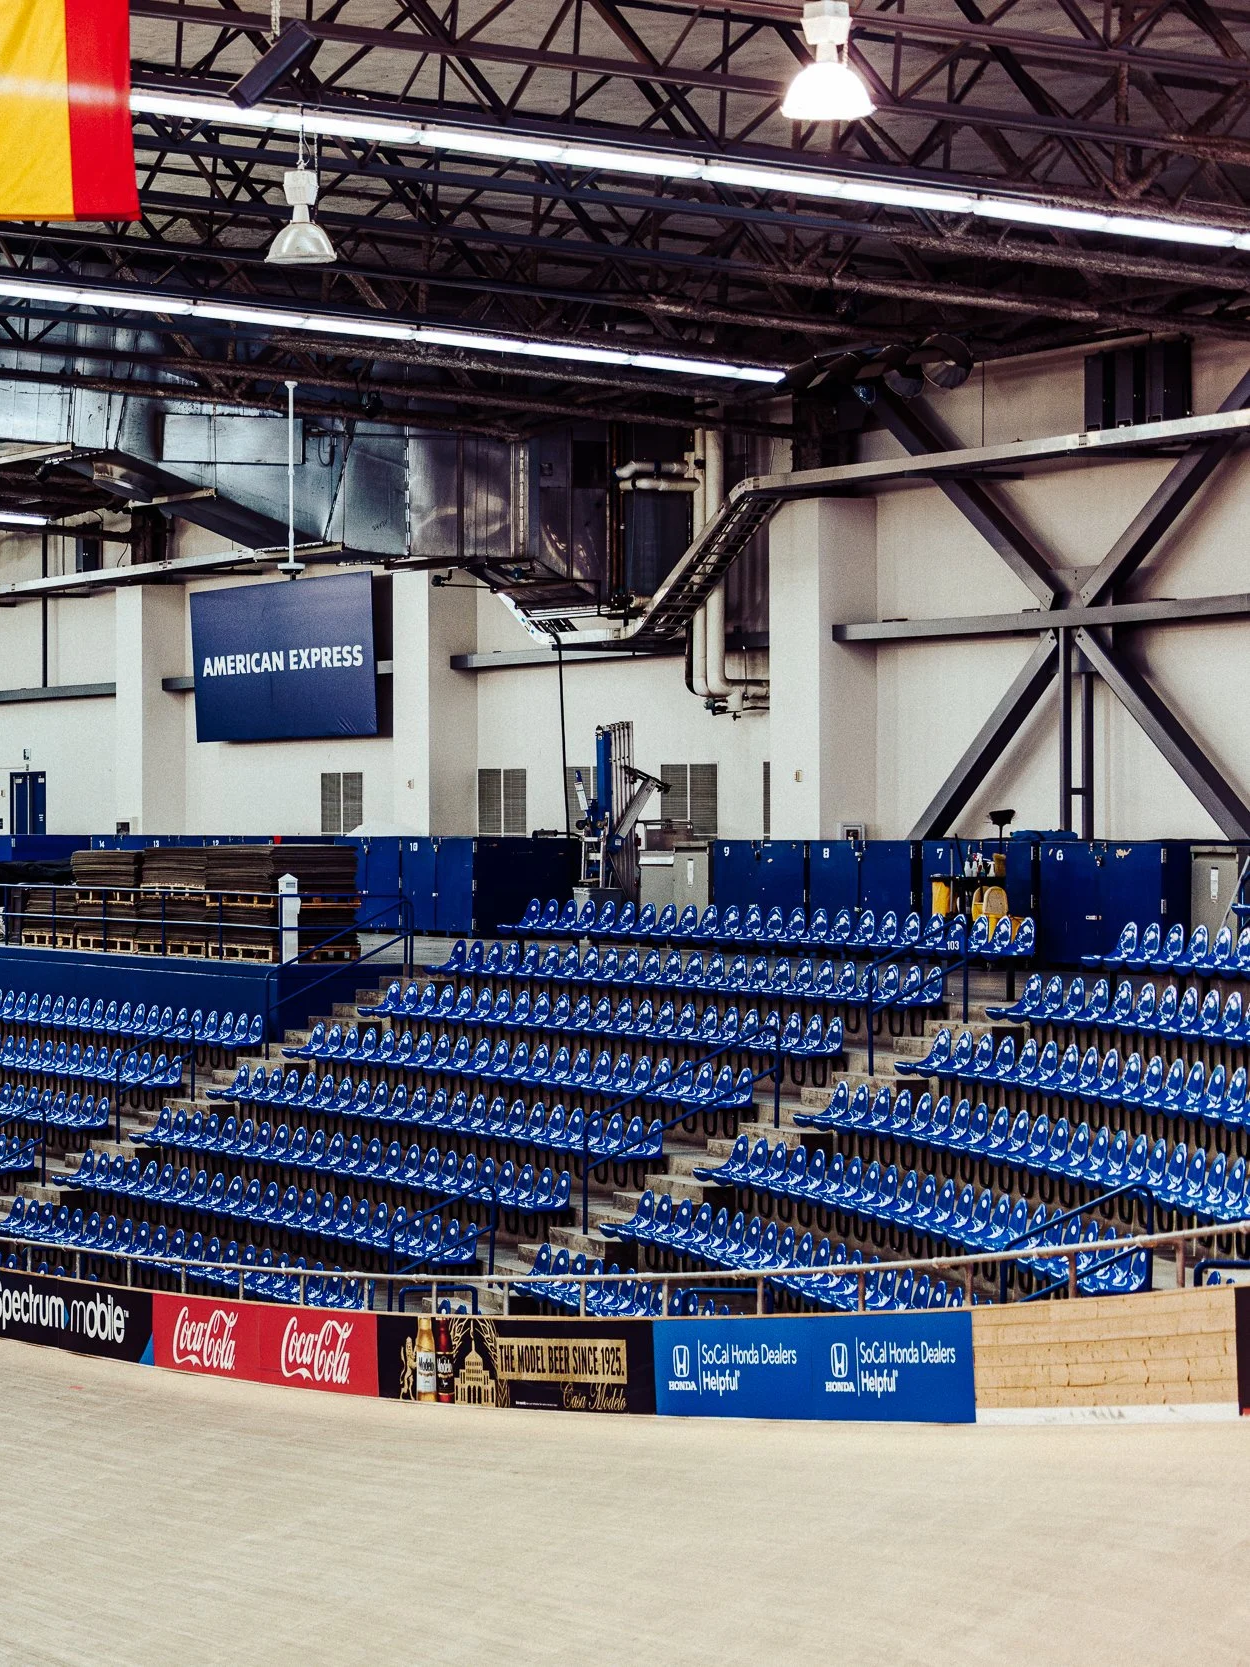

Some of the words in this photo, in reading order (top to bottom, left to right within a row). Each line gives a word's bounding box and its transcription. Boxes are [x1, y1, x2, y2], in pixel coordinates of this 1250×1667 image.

[202, 650, 285, 677] AMERICAN
[288, 644, 364, 671] EXPRESS
[153, 840, 159, 848] 13
[410, 842, 418, 851] 10
[723, 846, 730, 857] 9
[823, 847, 830, 859] 8
[937, 848, 944, 859] 7
[1056, 849, 1064, 861] 6
[946, 941, 960, 950] 103
[172, 1306, 239, 1371] Coca-Cola
[280, 1316, 354, 1385] Coca-Cola
[701, 1342, 729, 1365] SoCal
[731, 1342, 759, 1365] Honda
[761, 1342, 797, 1365] Dealers
[859, 1340, 887, 1364] SoCal
[889, 1340, 919, 1364] Honda
[920, 1340, 956, 1364] Dealers
[418, 1356, 435, 1372] Modelo
[498, 1344, 516, 1373] THE
[517, 1344, 546, 1374] MODEL
[548, 1345, 571, 1375] BEER
[572, 1345, 599, 1376] SINCE
[600, 1346, 625, 1377] 1925.
[668, 1380, 698, 1391] HONDA
[825, 1381, 856, 1392] HONDA
[560, 1381, 587, 1409] Casa
[589, 1382, 628, 1411] Modelo
